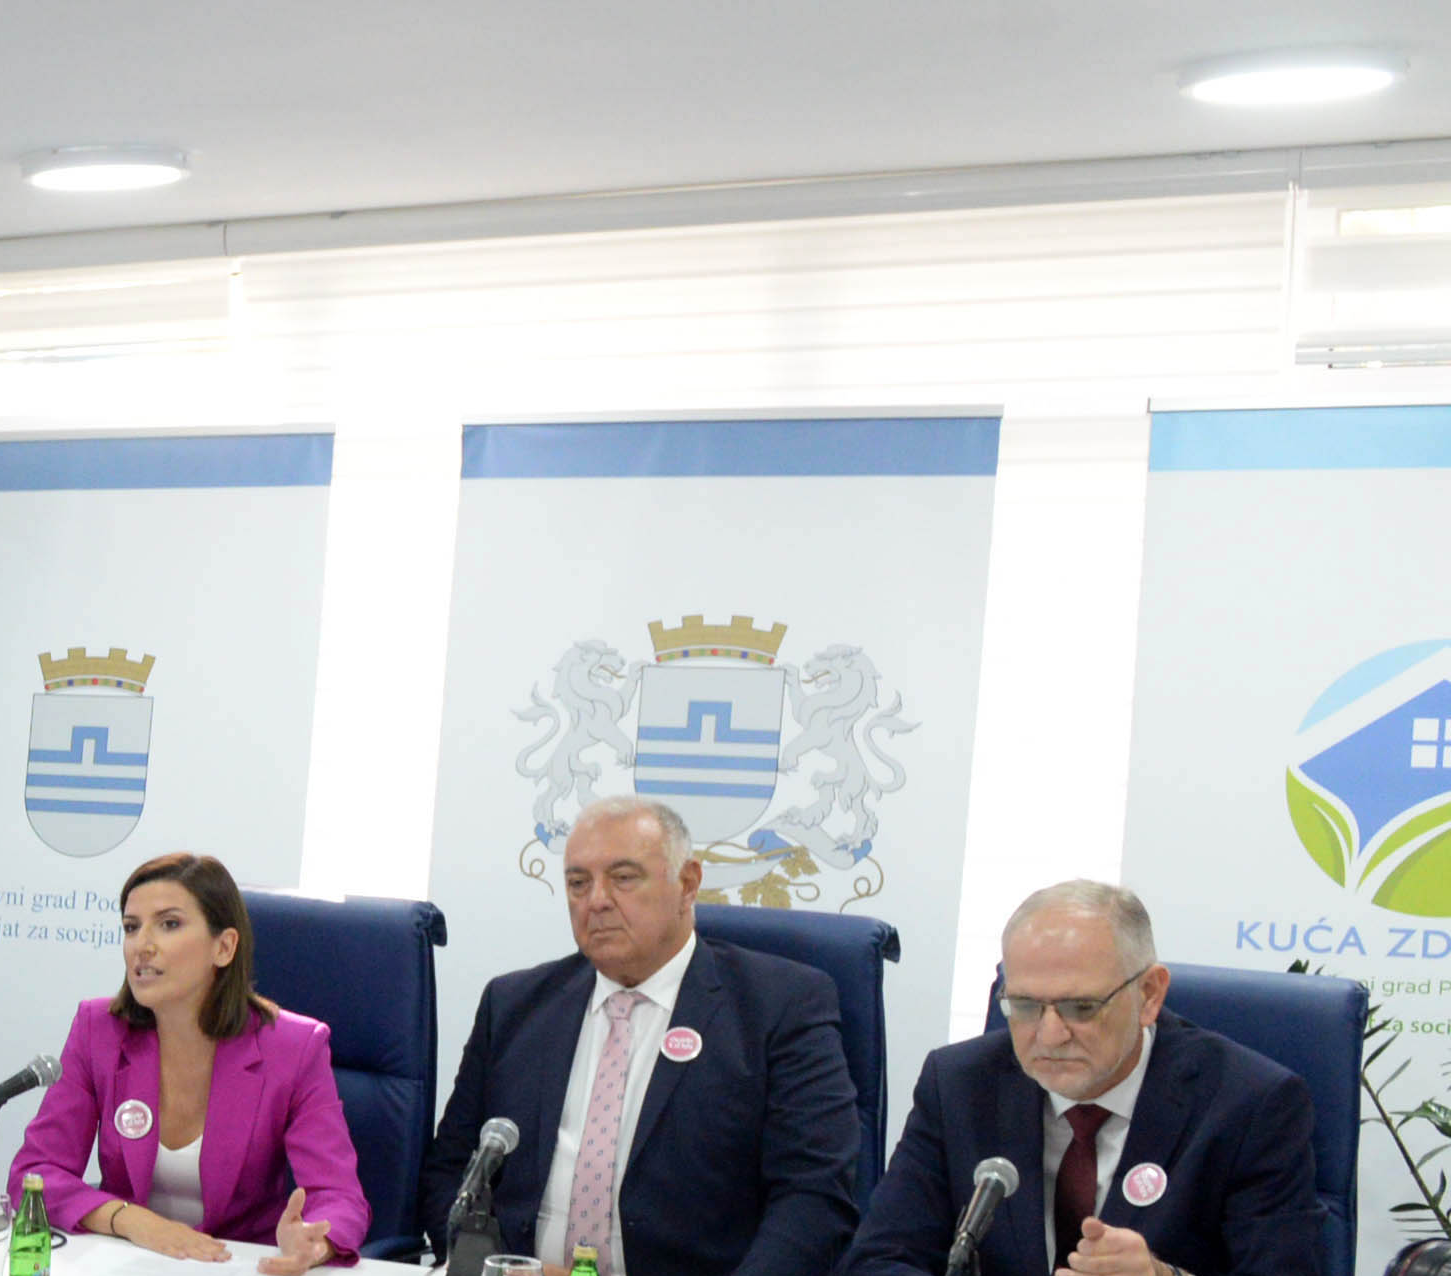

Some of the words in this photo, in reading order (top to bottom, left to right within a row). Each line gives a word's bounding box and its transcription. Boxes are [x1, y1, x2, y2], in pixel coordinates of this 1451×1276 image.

[31, 890, 76, 912] grad
[27, 925, 48, 939] za
[1236, 917, 1367, 956] KUĆA
[1382, 979, 1431, 997] grad
